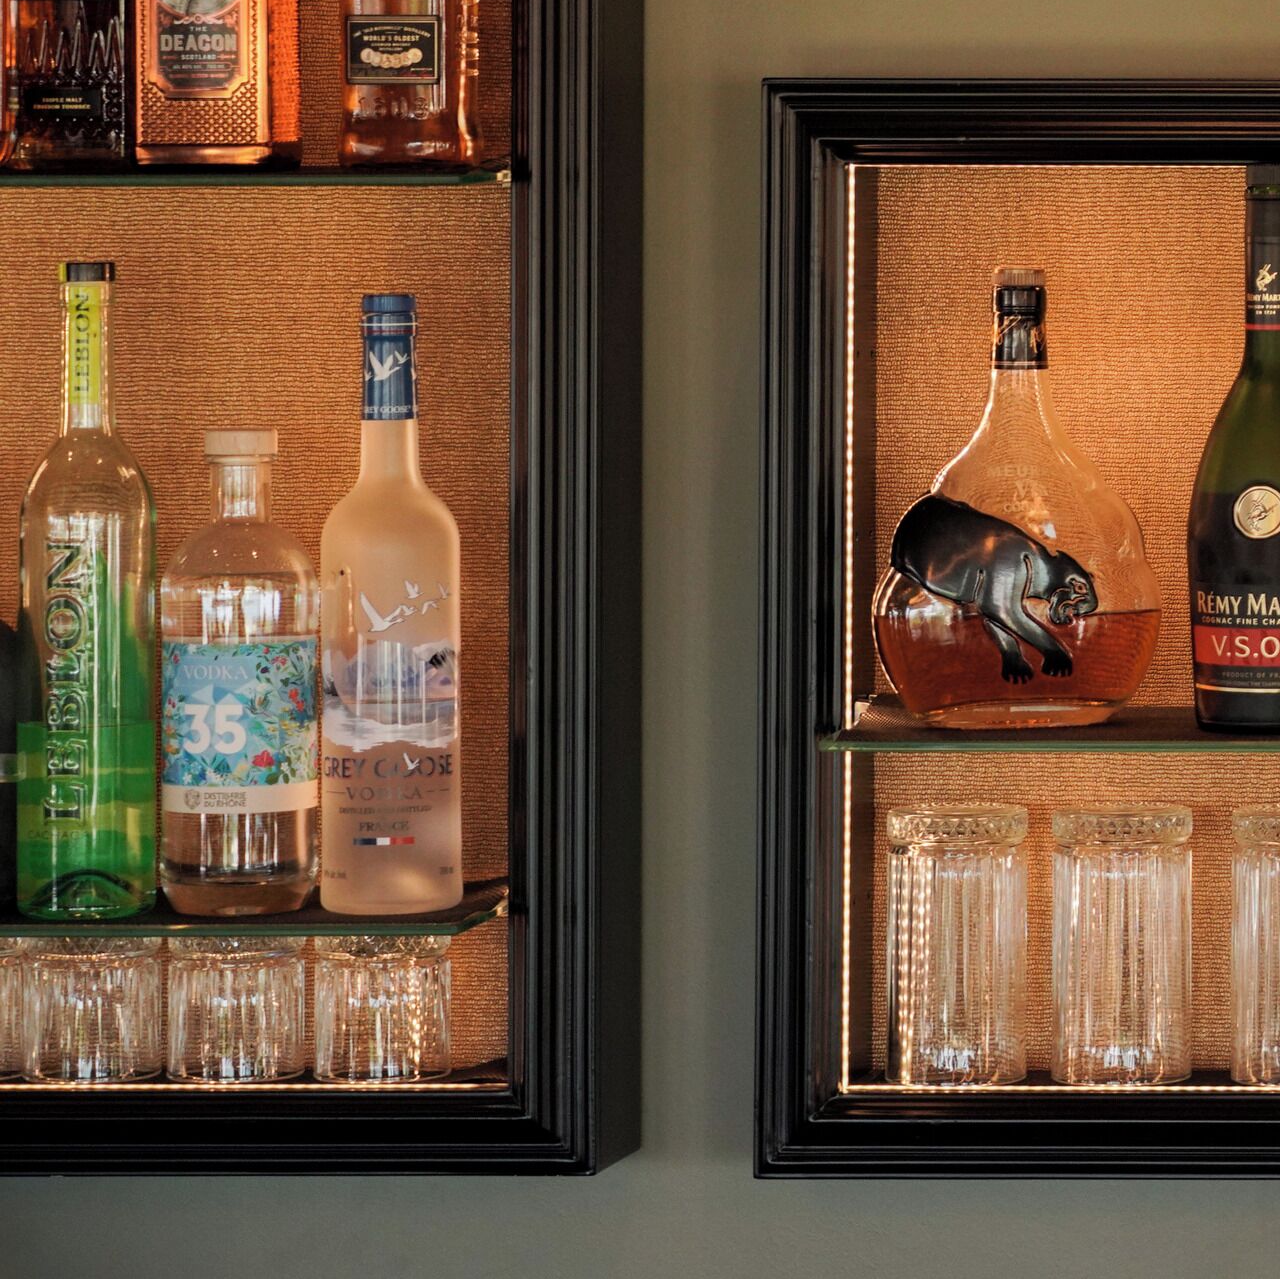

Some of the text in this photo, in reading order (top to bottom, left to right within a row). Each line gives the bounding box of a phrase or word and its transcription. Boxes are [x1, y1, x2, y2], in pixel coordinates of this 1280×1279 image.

[160, 33, 238, 52] DEACON
[74, 293, 90, 392] LEBLON
[1197, 591, 1242, 615] RÉMY
[1202, 615, 1233, 625] COGNAC
[1236, 616, 1259, 626] FINE
[44, 542, 86, 826] LEBLON
[183, 665, 249, 680] VODKA
[182, 704, 247, 755] 35
[324, 756, 367, 779] GREY
[216, 799, 248, 808] RHÔNE
